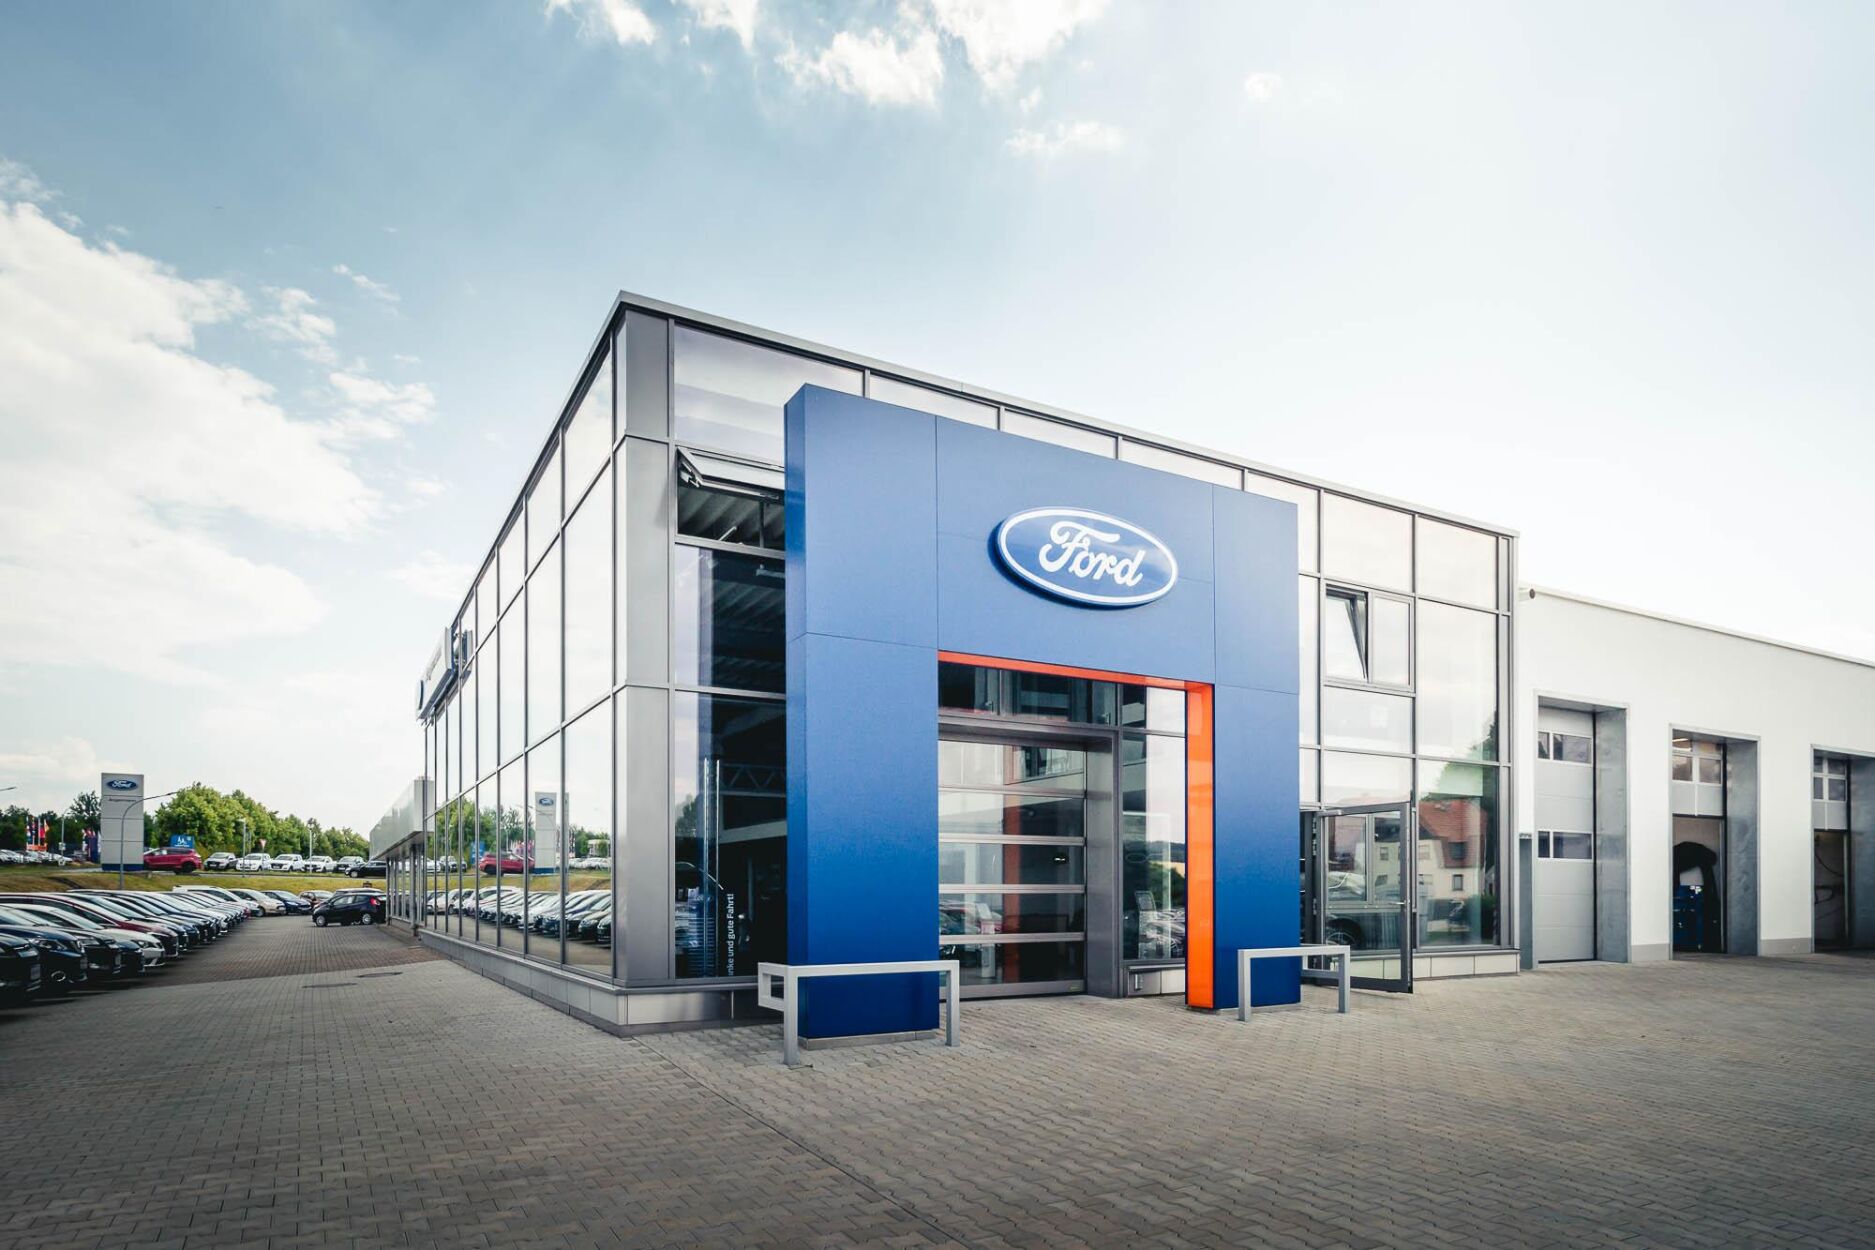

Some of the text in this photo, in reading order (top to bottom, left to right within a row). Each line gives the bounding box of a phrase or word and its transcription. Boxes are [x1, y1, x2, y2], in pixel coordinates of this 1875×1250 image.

[1038, 520, 1147, 587] Ford
[726, 893, 734, 919] Fahrt!
[727, 920, 735, 940] gute
[726, 941, 734, 957] und
